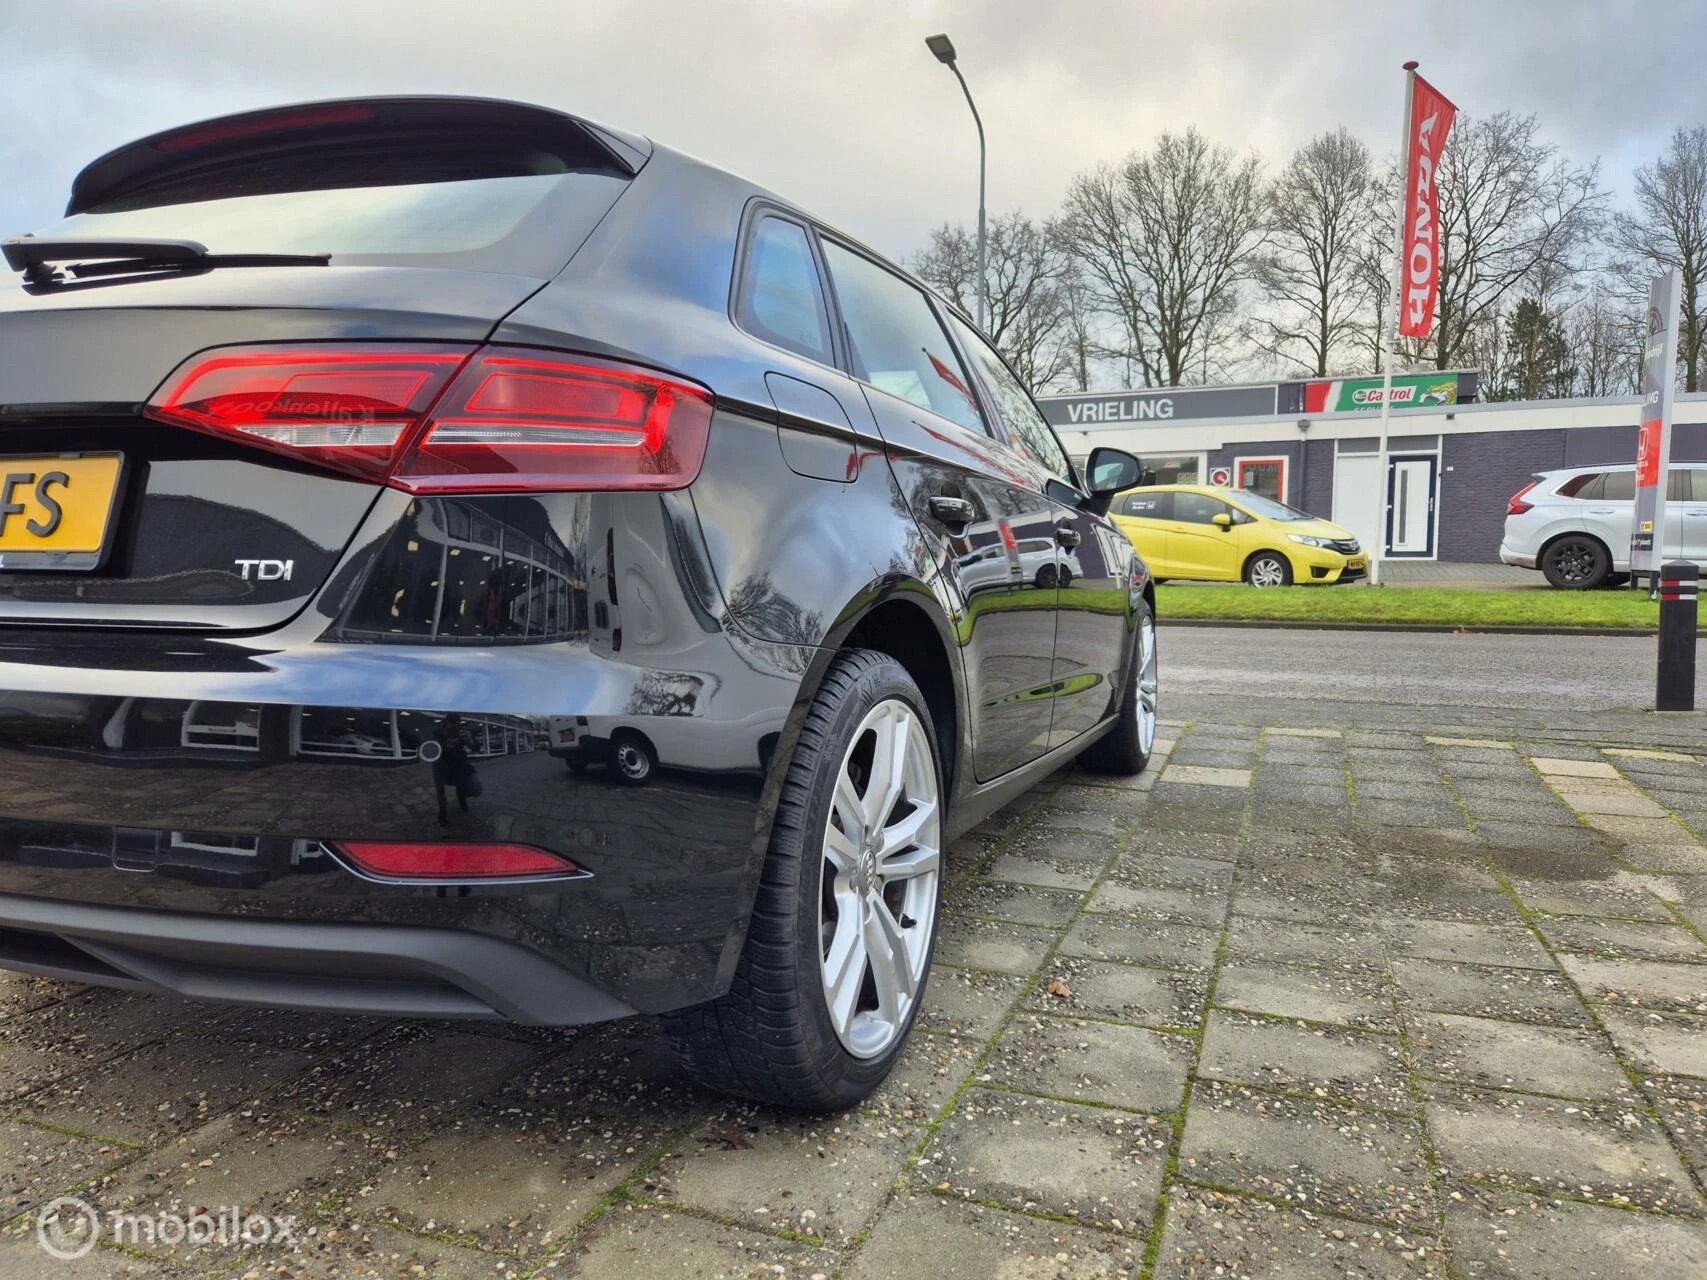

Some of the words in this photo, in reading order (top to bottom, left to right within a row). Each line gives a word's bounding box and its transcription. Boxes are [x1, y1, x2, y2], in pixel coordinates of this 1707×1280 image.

[1409, 111, 1439, 328] HONDA
[1367, 387, 1412, 402] Catrol
[1067, 398, 1174, 423] VRIELING
[0, 471, 70, 538] FS
[234, 559, 294, 581] TDI
